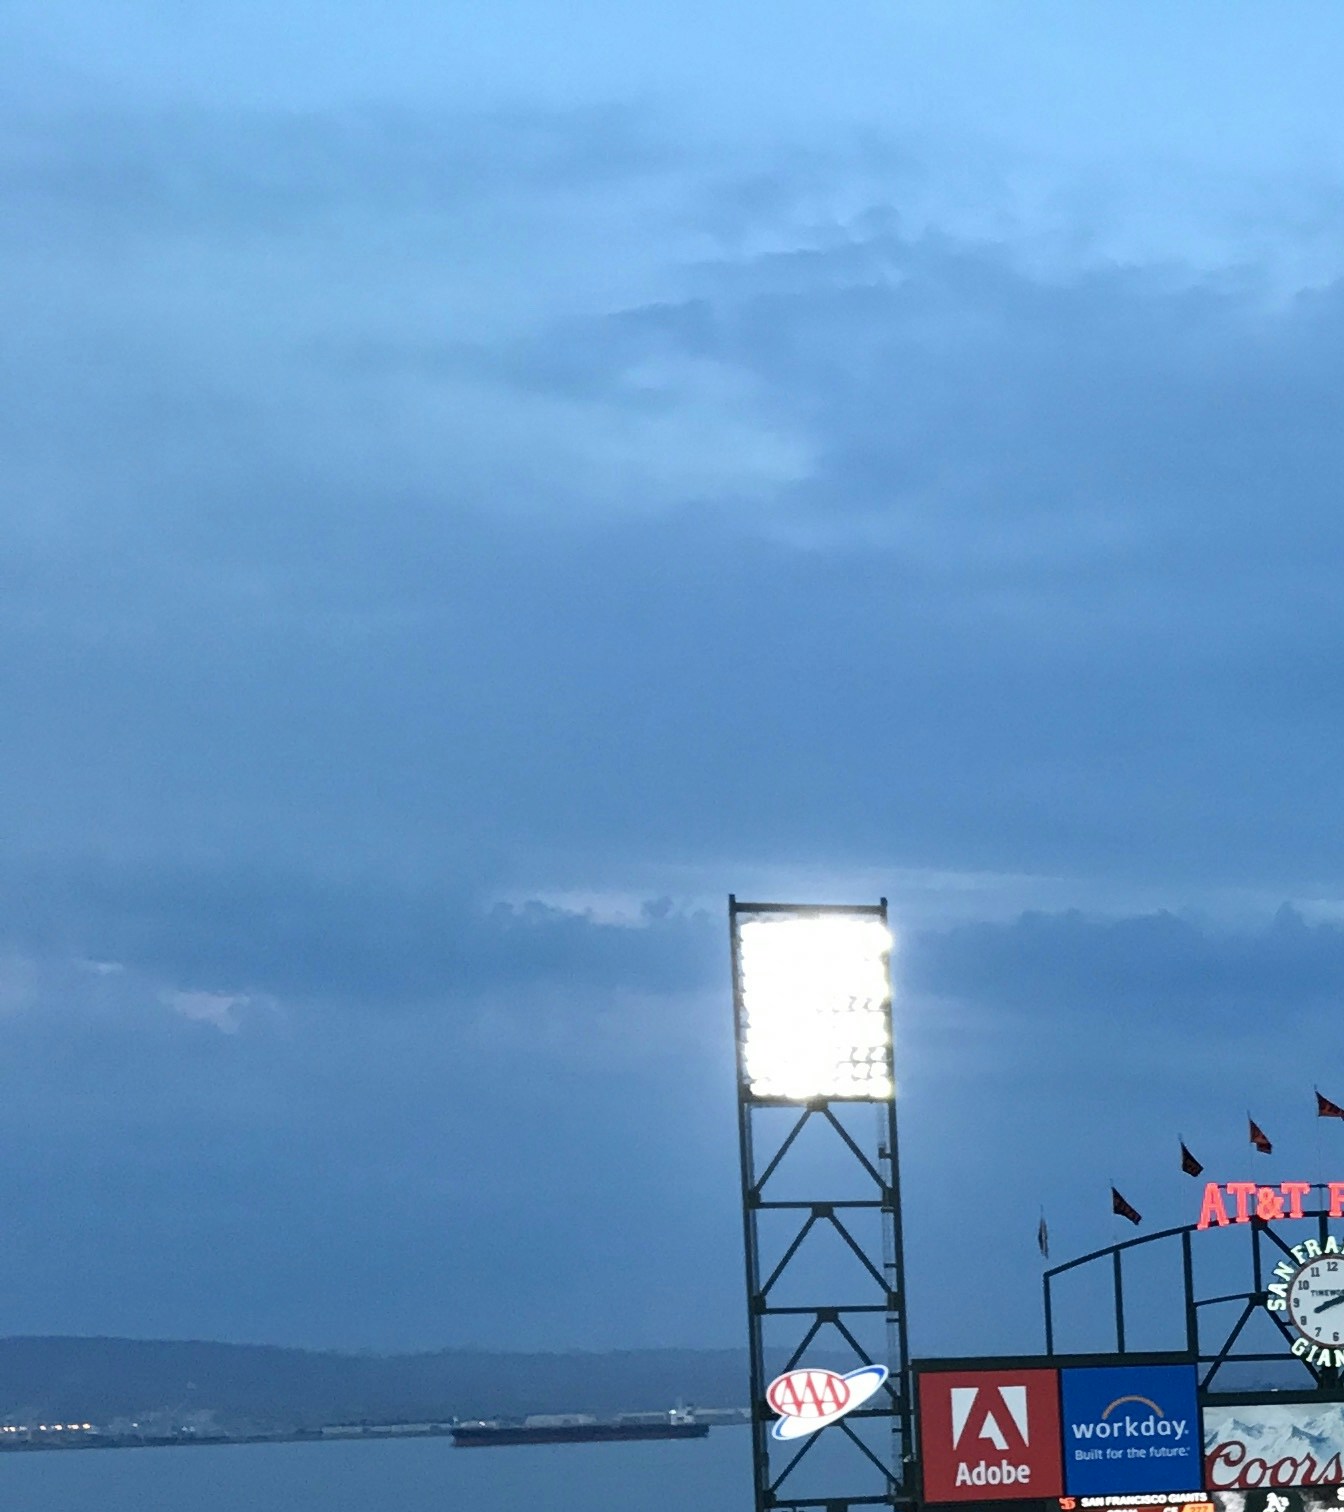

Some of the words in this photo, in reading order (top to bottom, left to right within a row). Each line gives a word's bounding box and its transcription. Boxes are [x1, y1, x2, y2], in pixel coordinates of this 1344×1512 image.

[1197, 1181, 1310, 1231] AT&T
[1327, 1261, 1339, 1272] 12
[1310, 1267, 1320, 1278] 11
[1266, 1260, 1295, 1312] SAN
[1298, 1280, 1310, 1291] 10
[1293, 1297, 1300, 1308] 9
[1300, 1315, 1307, 1326] 8
[1315, 1326, 1322, 1337] 7
[1332, 1332, 1340, 1342] 6
[774, 1370, 846, 1417] AAA
[1075, 1449, 1103, 1461] Built
[1106, 1447, 1123, 1459] for
[1127, 1447, 1146, 1458] the
[955, 1459, 1031, 1486] Adobe
[1081, 1497, 1104, 1507] SAN
[1106, 1494, 1167, 1506] FRANCISCO
[1168, 1492, 1207, 1503] GIANTS
